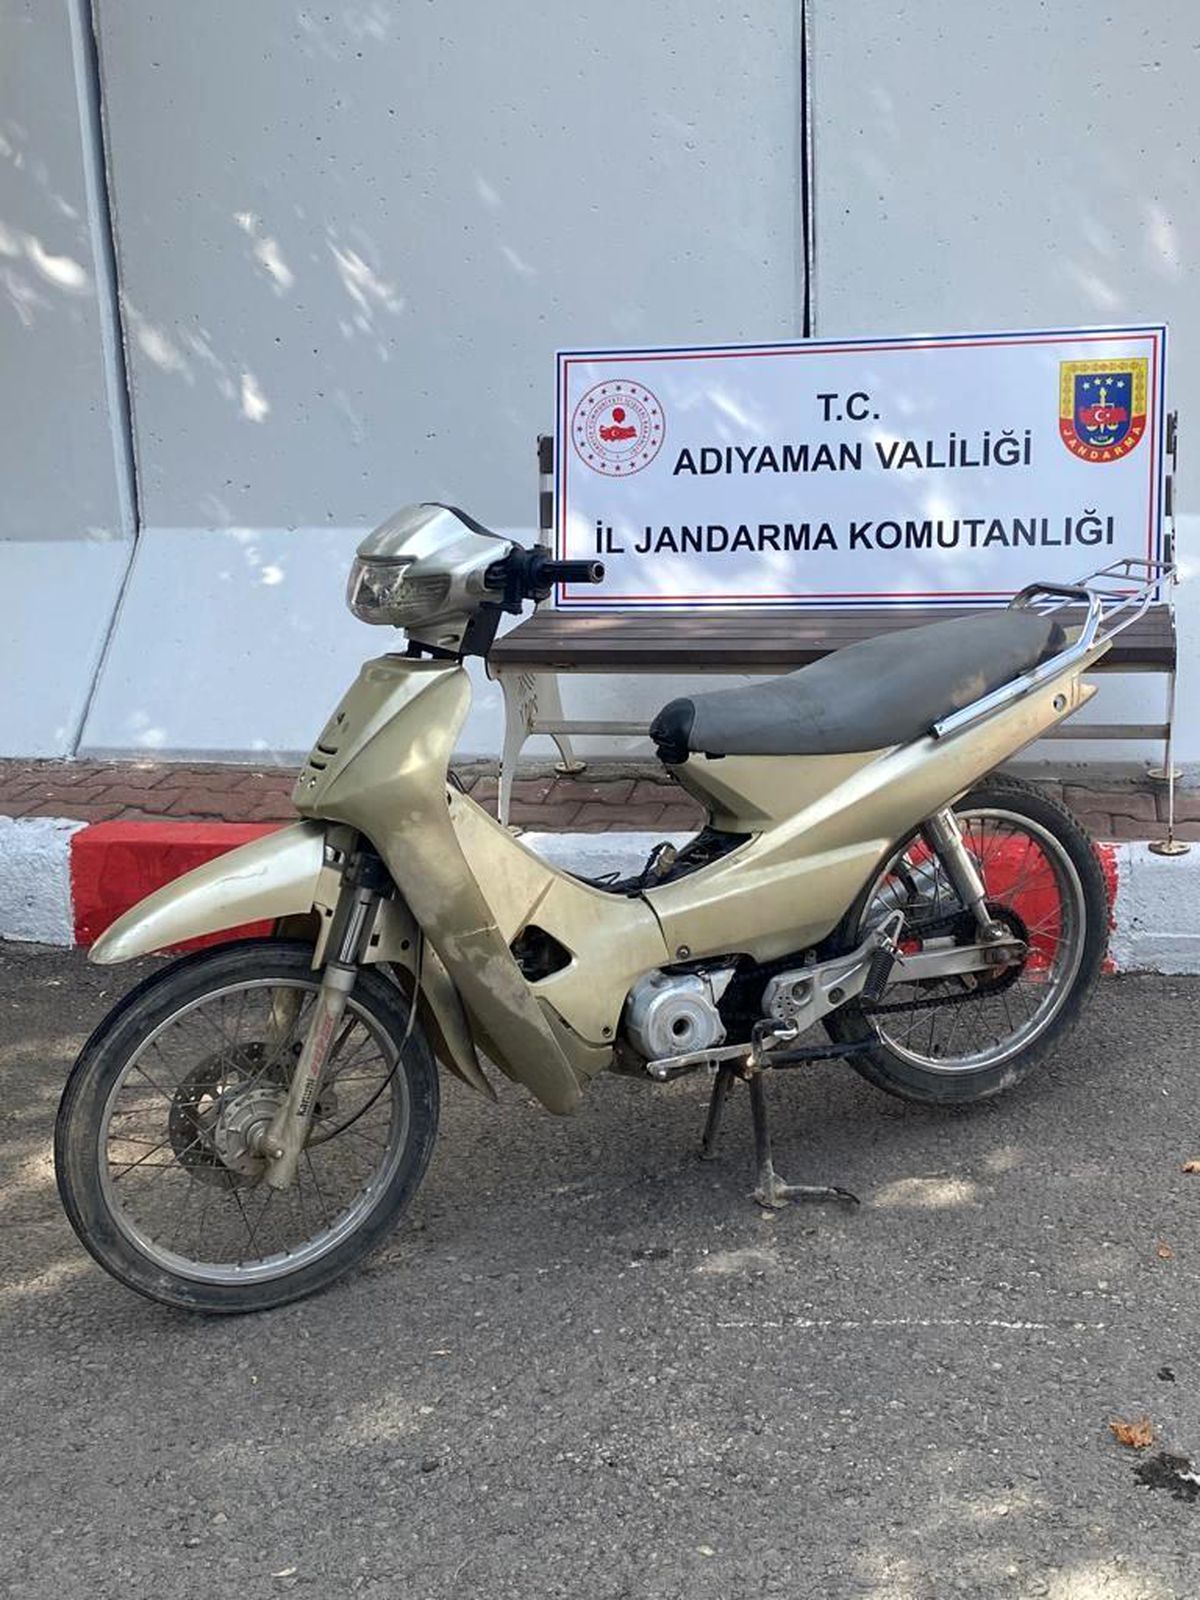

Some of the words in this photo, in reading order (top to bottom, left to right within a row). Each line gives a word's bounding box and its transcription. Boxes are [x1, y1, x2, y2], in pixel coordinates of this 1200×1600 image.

[816, 393, 880, 422] T.C.
[673, 443, 862, 475] ADIYAMAN
[876, 429, 1031, 470] VALİLİĞİ
[1063, 427, 1142, 460] JANDARMA
[596, 520, 624, 553] İL
[635, 522, 838, 554] JANDARMA
[849, 508, 1114, 550] KOMUTANLIĞI
